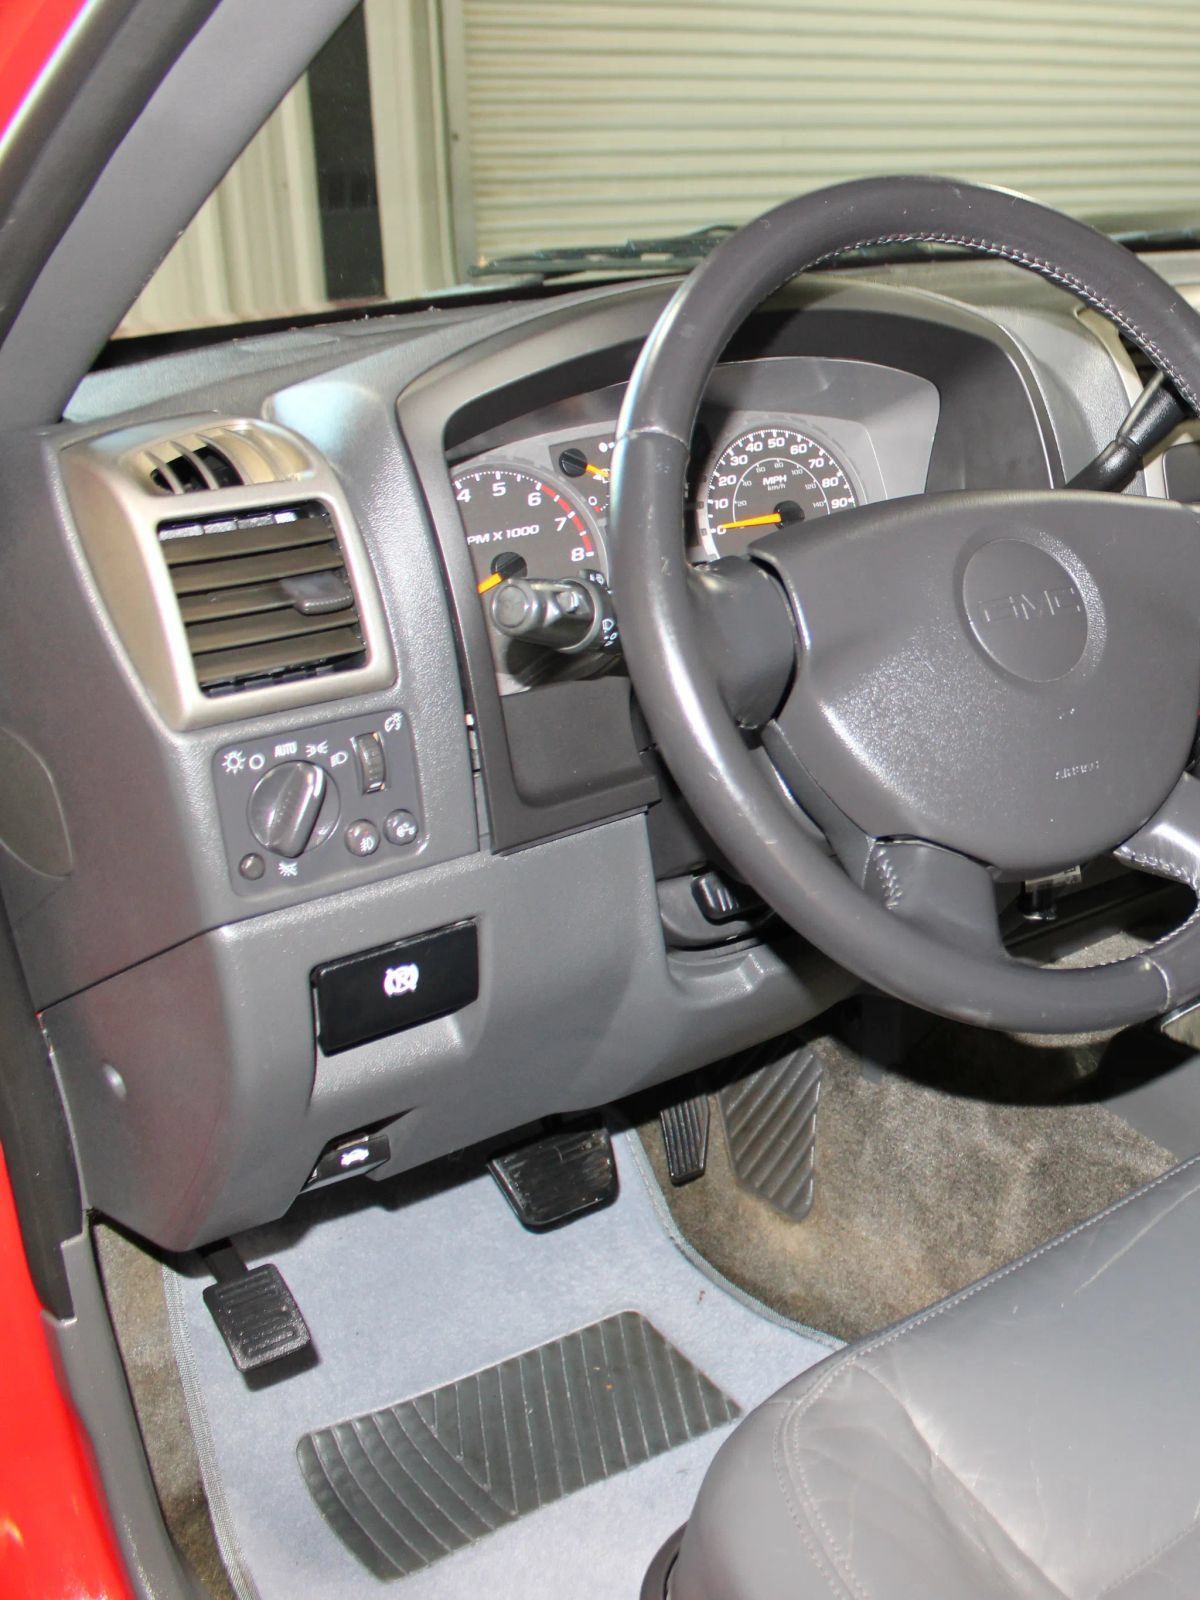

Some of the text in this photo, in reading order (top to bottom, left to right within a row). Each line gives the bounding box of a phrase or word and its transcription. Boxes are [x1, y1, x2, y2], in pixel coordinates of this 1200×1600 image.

[745, 442, 763, 452] 40
[768, 437, 786, 448] 50
[790, 444, 808, 455] 60
[730, 455, 748, 466] 30
[808, 458, 824, 468] 70
[718, 475, 736, 486] 20
[762, 474, 787, 486] MPH
[822, 477, 839, 488] 80
[492, 482, 506, 496] 5
[457, 489, 471, 502] 4
[528, 492, 542, 506] 6
[714, 498, 728, 509] 10
[831, 498, 848, 509] 90
[554, 517, 567, 532] 7
[716, 525, 726, 535] 0
[467, 524, 540, 545] PM X 1000
[571, 547, 585, 562] 8
[274, 742, 297, 758] AUTO
